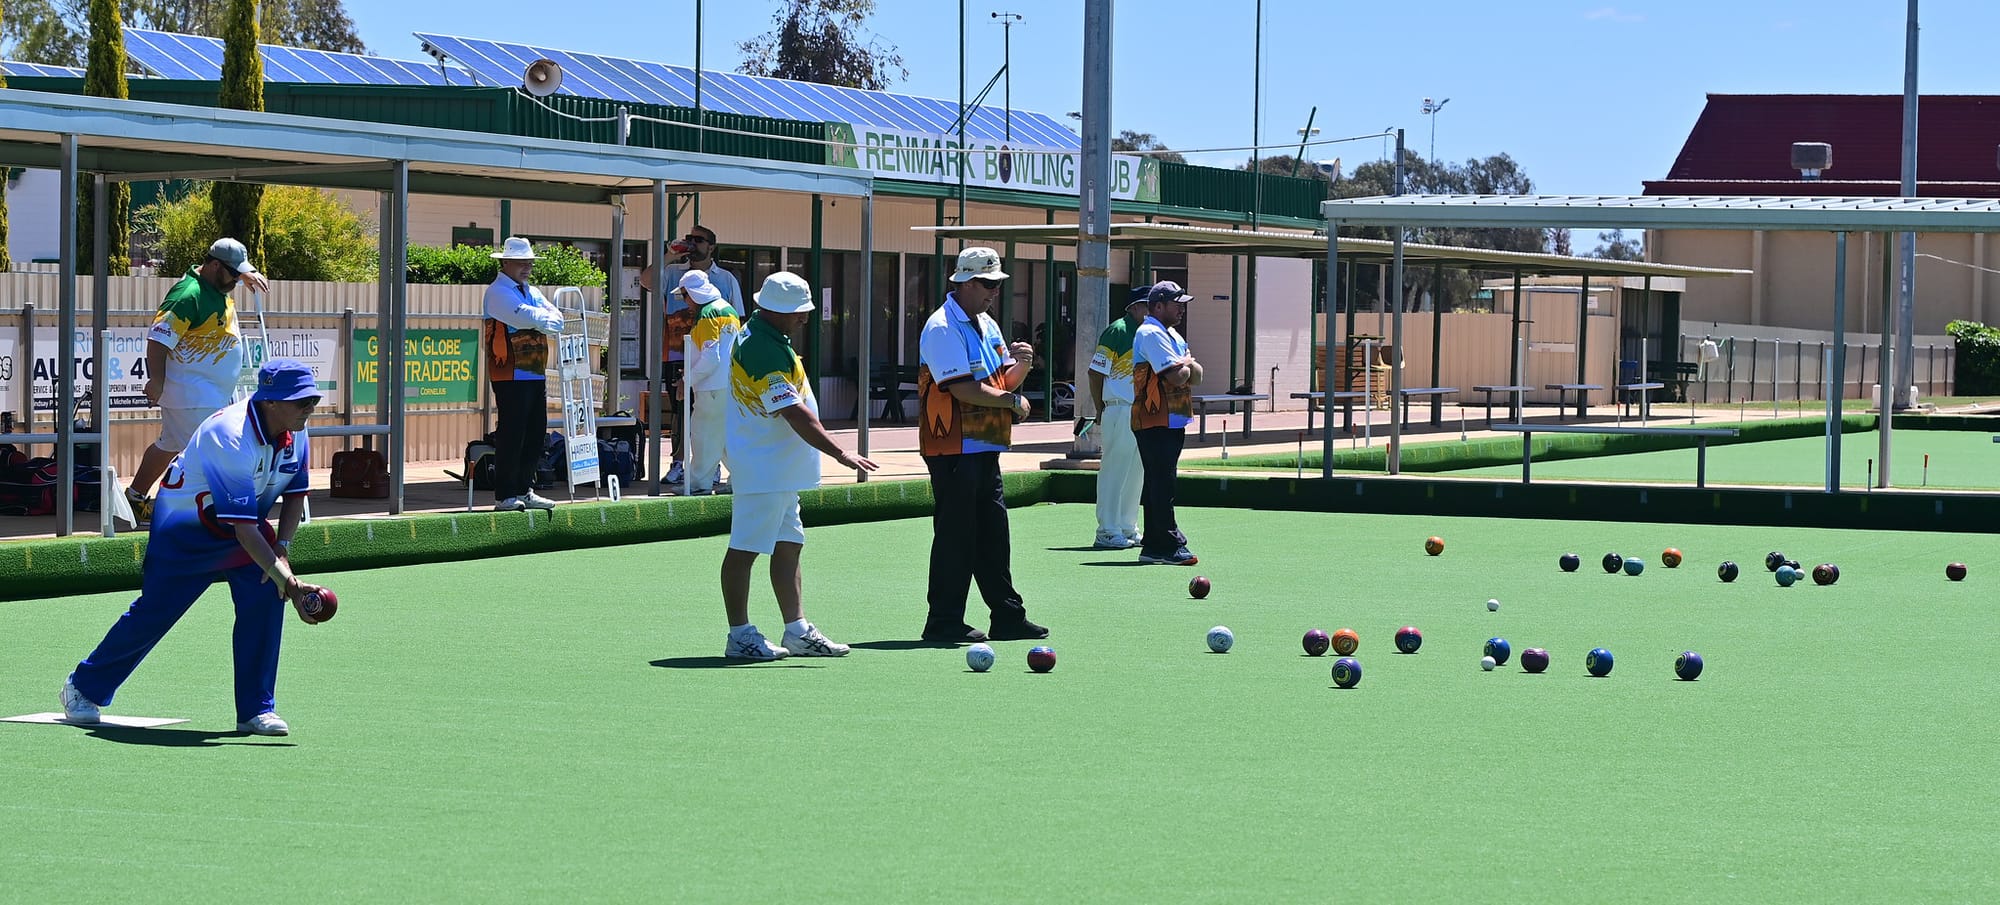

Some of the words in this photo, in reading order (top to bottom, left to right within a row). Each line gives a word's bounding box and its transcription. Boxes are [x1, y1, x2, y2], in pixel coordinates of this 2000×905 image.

[865, 131, 976, 180] RENMARK
[1110, 157, 1130, 194] UB
[75, 331, 143, 353] Riland
[292, 334, 319, 357] Ellis
[367, 335, 417, 356] GEN
[110, 357, 123, 380] &
[404, 360, 470, 382] TRADERS
[33, 385, 48, 394] ERVICE
[32, 400, 49, 409] indsay
